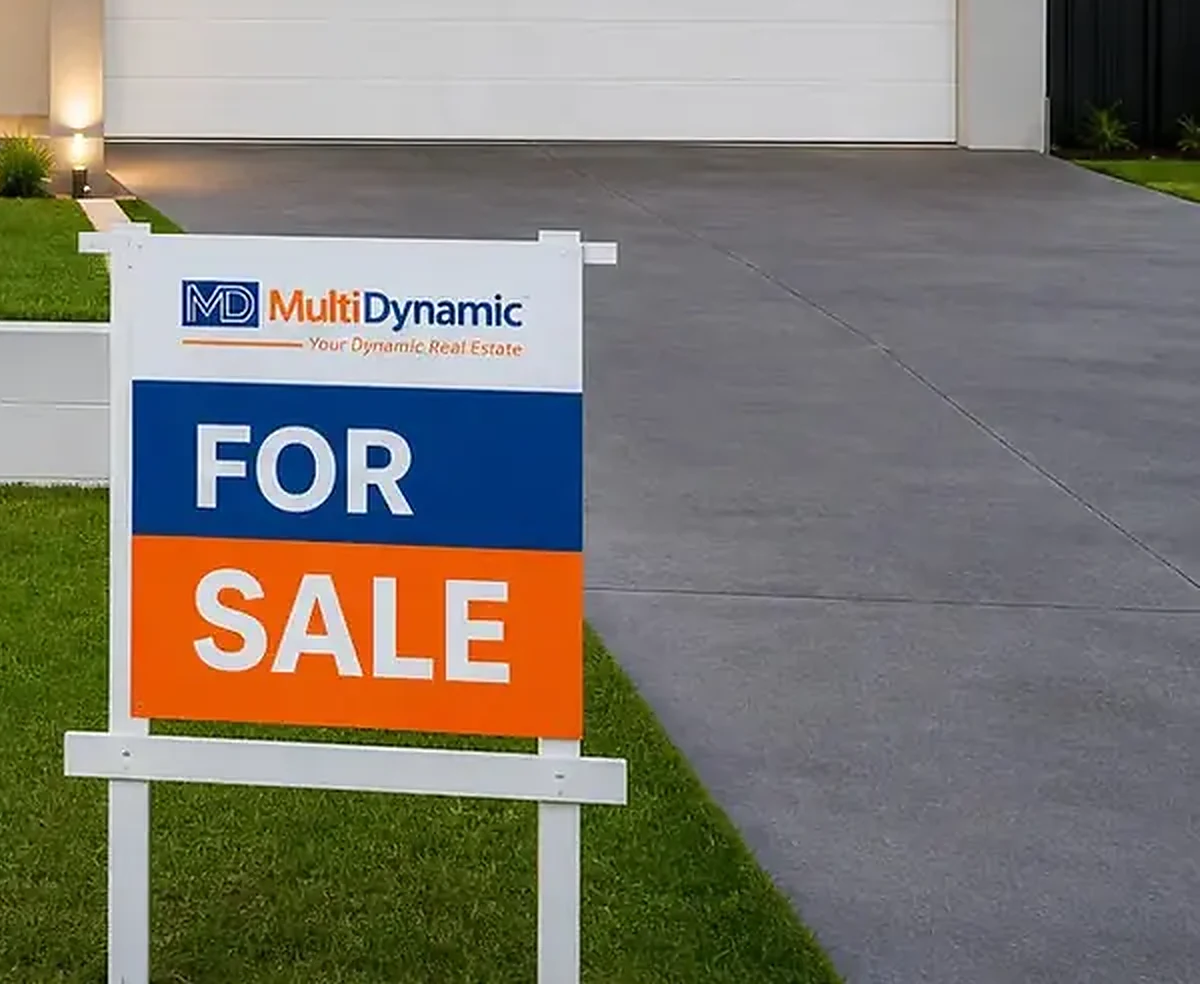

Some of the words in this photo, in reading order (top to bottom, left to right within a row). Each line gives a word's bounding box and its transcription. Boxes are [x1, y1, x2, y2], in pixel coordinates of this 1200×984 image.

[186, 283, 255, 324] MD
[269, 289, 523, 331] MultiDynamic
[308, 336, 345, 351] Your
[351, 338, 424, 356] Dynamic
[428, 340, 466, 354] Real
[470, 343, 523, 357] Estate
[196, 424, 414, 515] FOR
[193, 568, 511, 684] SALE
